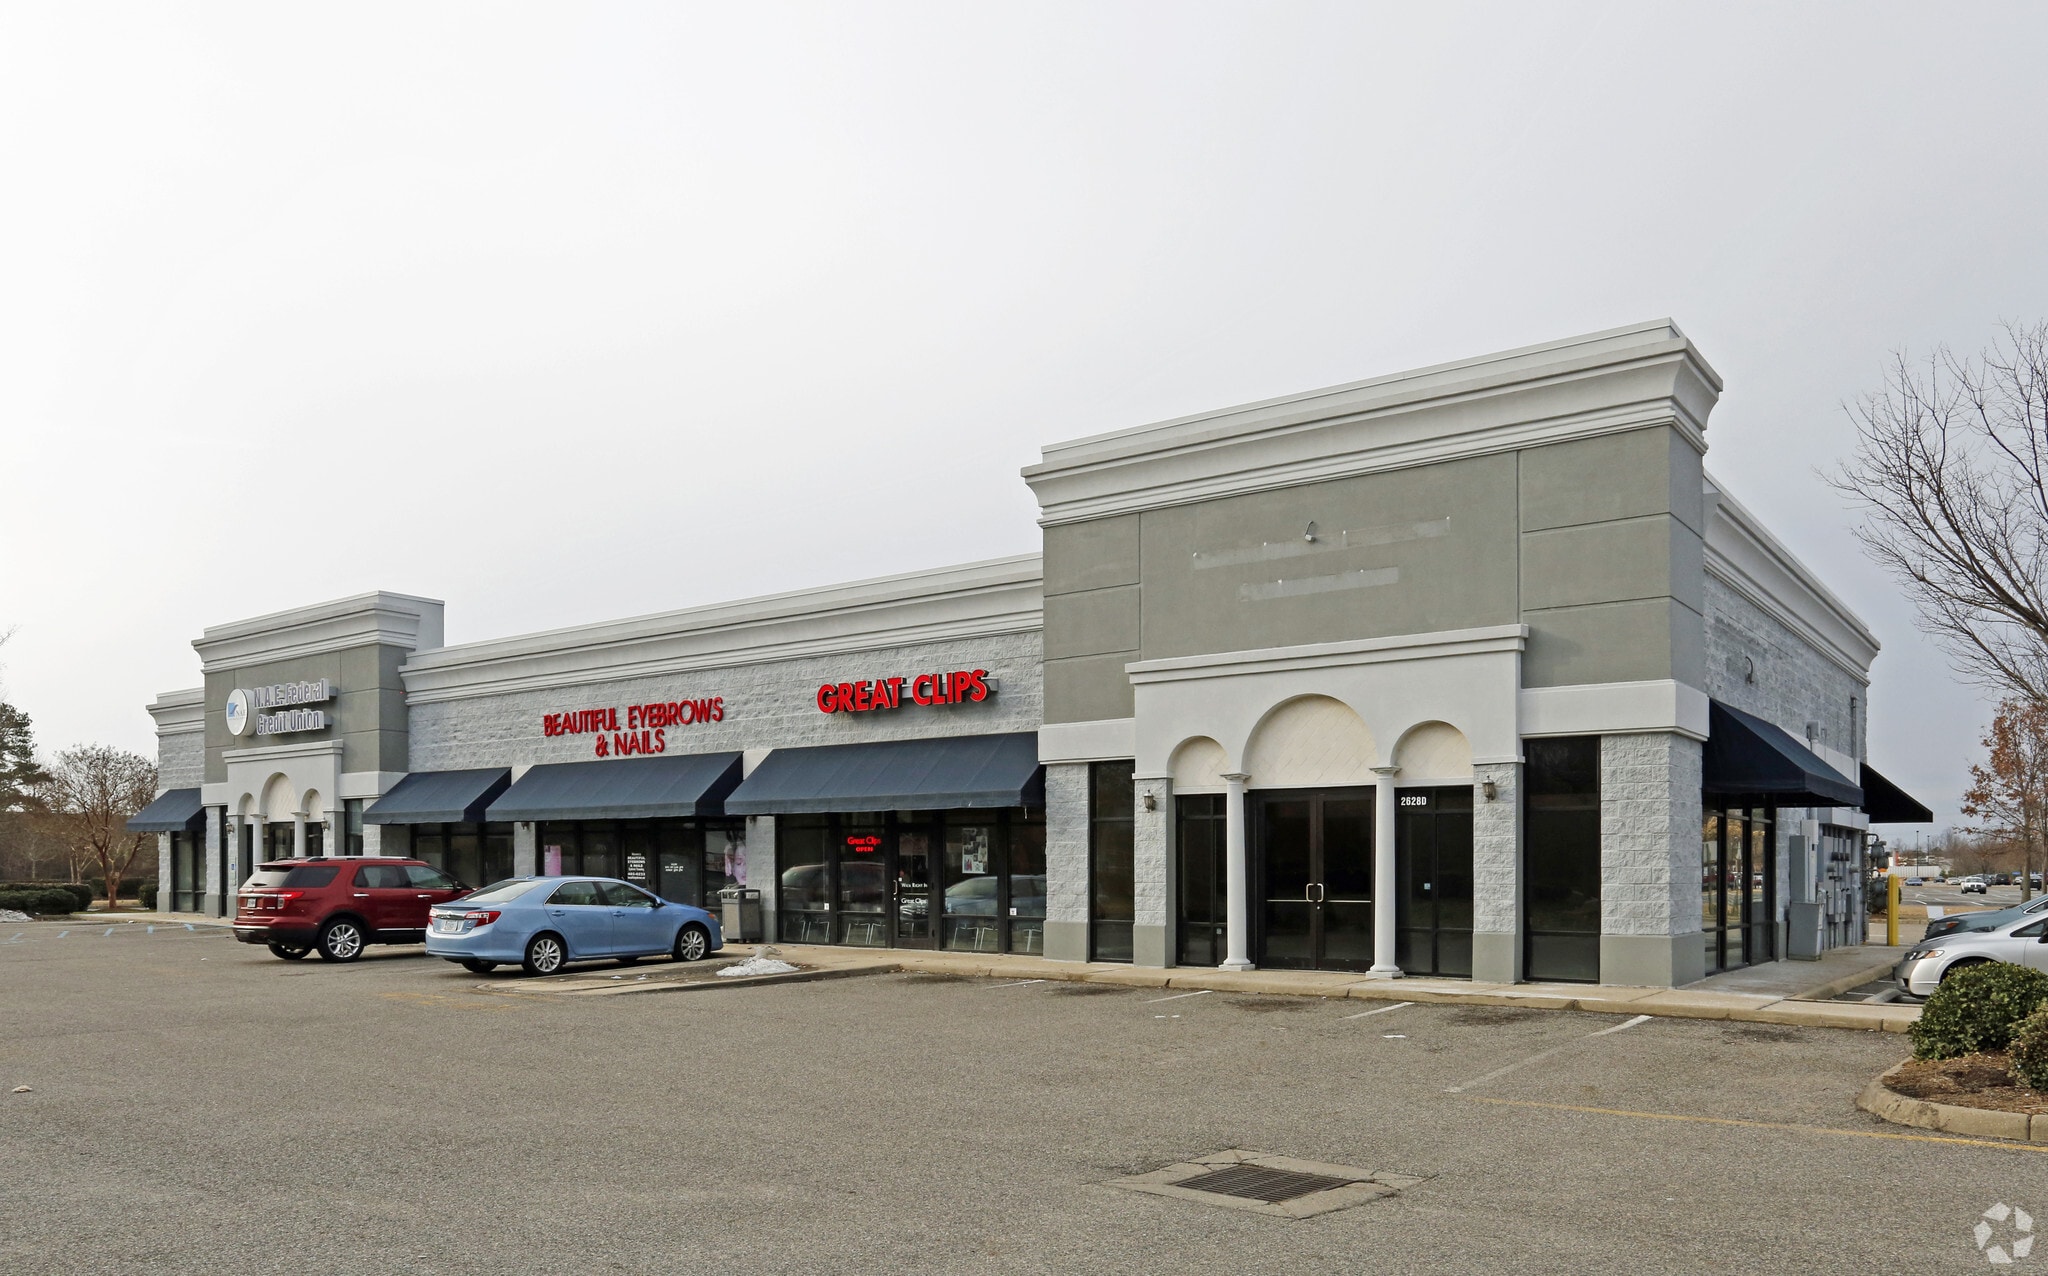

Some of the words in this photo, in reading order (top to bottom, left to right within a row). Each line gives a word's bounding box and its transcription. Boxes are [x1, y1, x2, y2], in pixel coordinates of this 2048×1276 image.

[285, 678, 327, 704] Federal
[817, 676, 904, 713] GREAT
[912, 669, 988, 706] CLIPS
[256, 712, 287, 735] Credit
[289, 708, 323, 732] Union
[543, 707, 621, 737] BEAUTIFUL
[627, 696, 724, 729] EYEBROWS
[595, 733, 609, 757] &
[614, 728, 666, 755] NAILS
[1400, 796, 1427, 806] 2628D
